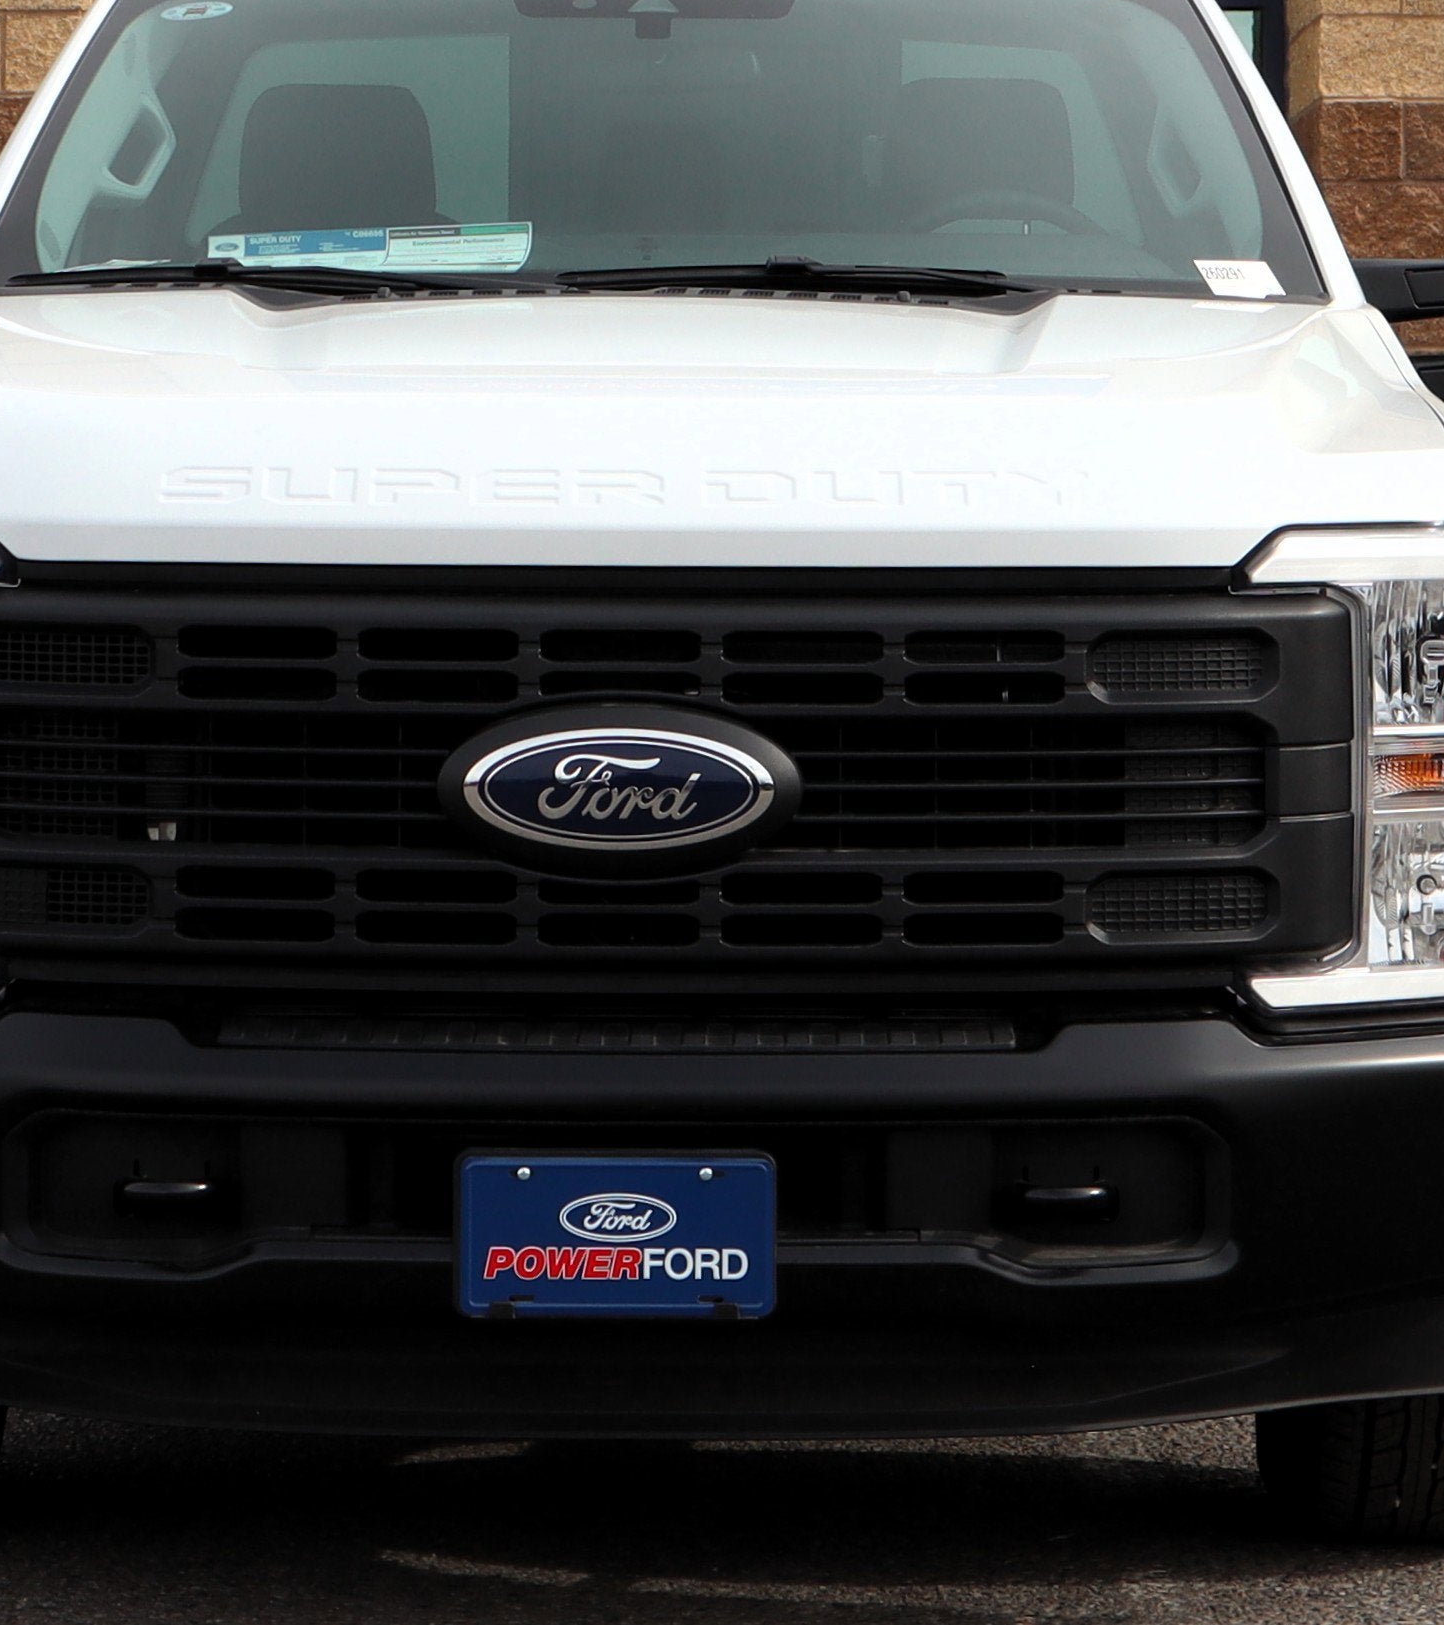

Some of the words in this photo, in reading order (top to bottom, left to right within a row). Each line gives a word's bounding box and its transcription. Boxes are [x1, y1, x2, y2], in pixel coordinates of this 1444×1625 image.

[278, 235, 302, 244] DUTY
[159, 466, 668, 507] SUPER
[703, 468, 1094, 507] DUTY
[538, 754, 701, 820] Ford
[583, 1202, 652, 1230] Ford
